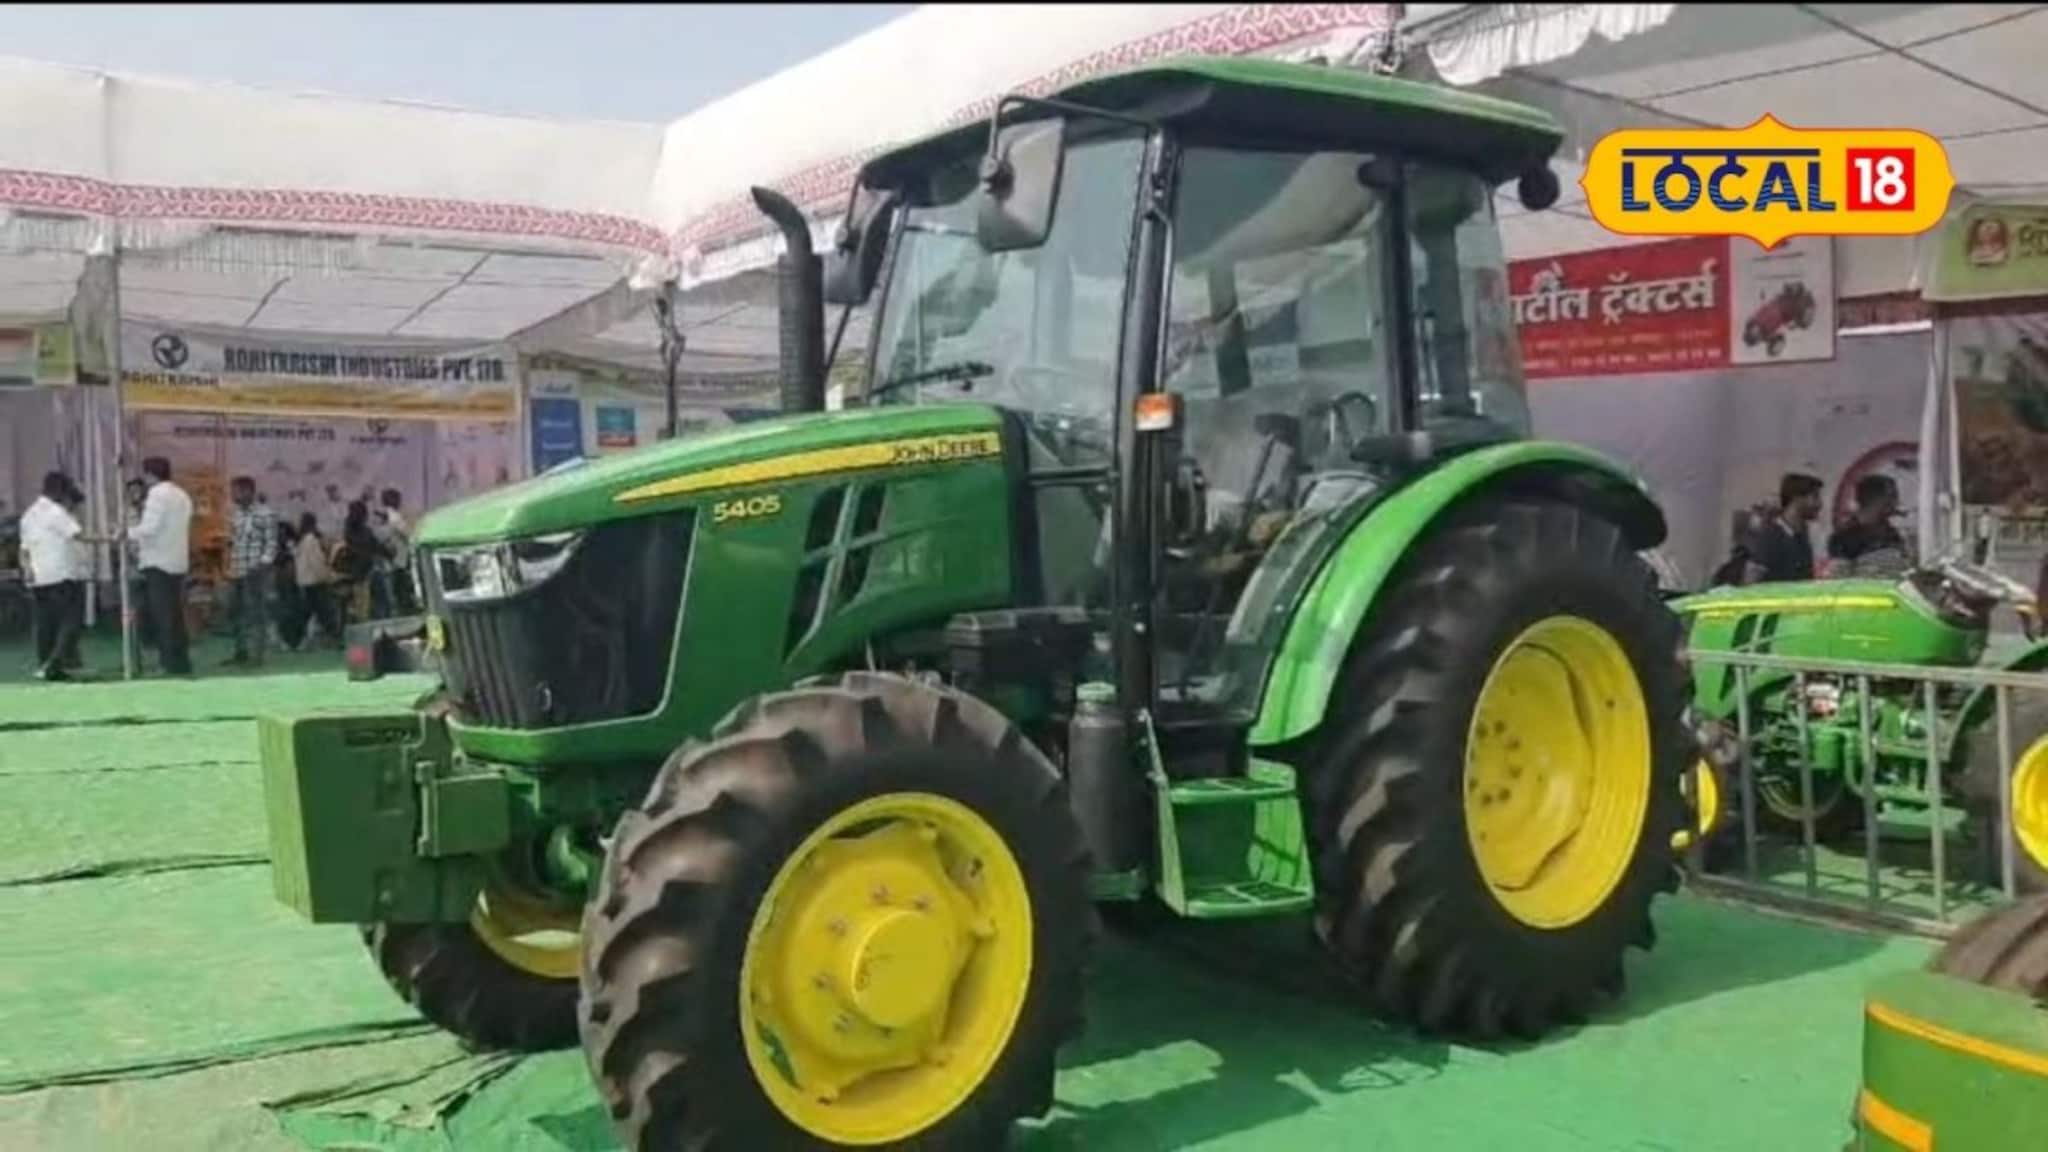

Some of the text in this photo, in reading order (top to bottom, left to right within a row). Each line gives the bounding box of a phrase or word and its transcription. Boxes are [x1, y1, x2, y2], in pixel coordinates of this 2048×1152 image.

[890, 438, 989, 464] JOHN DEERE
[712, 495, 781, 521] 5405
